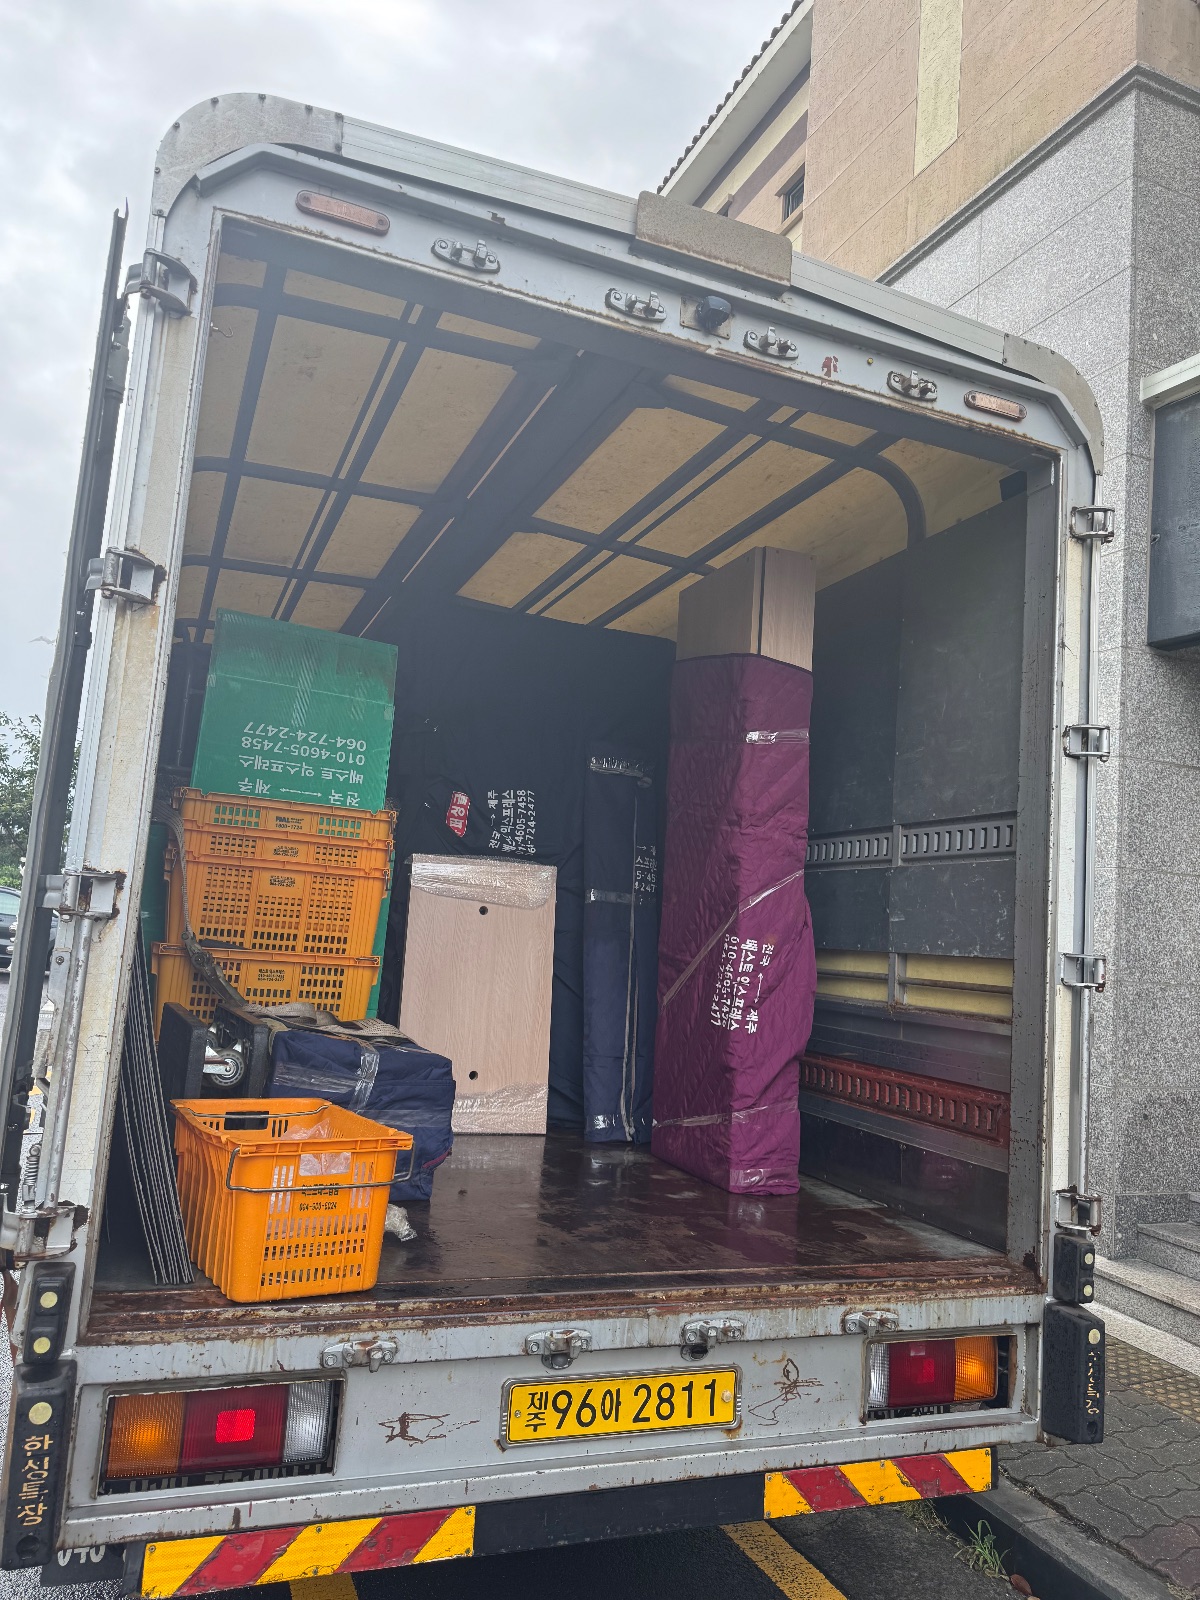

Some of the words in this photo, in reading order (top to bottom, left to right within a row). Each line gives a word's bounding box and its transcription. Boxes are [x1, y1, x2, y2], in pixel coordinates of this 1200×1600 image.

[242, 721, 367, 752] 064-724-2477
[240, 736, 366, 766] 010-4605-7458
[238, 754, 315, 777] 익스프레스
[320, 767, 364, 785] 베스트
[237, 777, 272, 795] 제주
[328, 788, 361, 807] 전국
[487, 789, 499, 810] 제주
[500, 789, 516, 833] 익스프레스
[738, 938, 758, 973] 베스트
[759, 942, 775, 967] 전국
[727, 975, 751, 1031] 익스프레스
[744, 1008, 759, 1035] 제주
[631, 1378, 718, 1424] 2811
